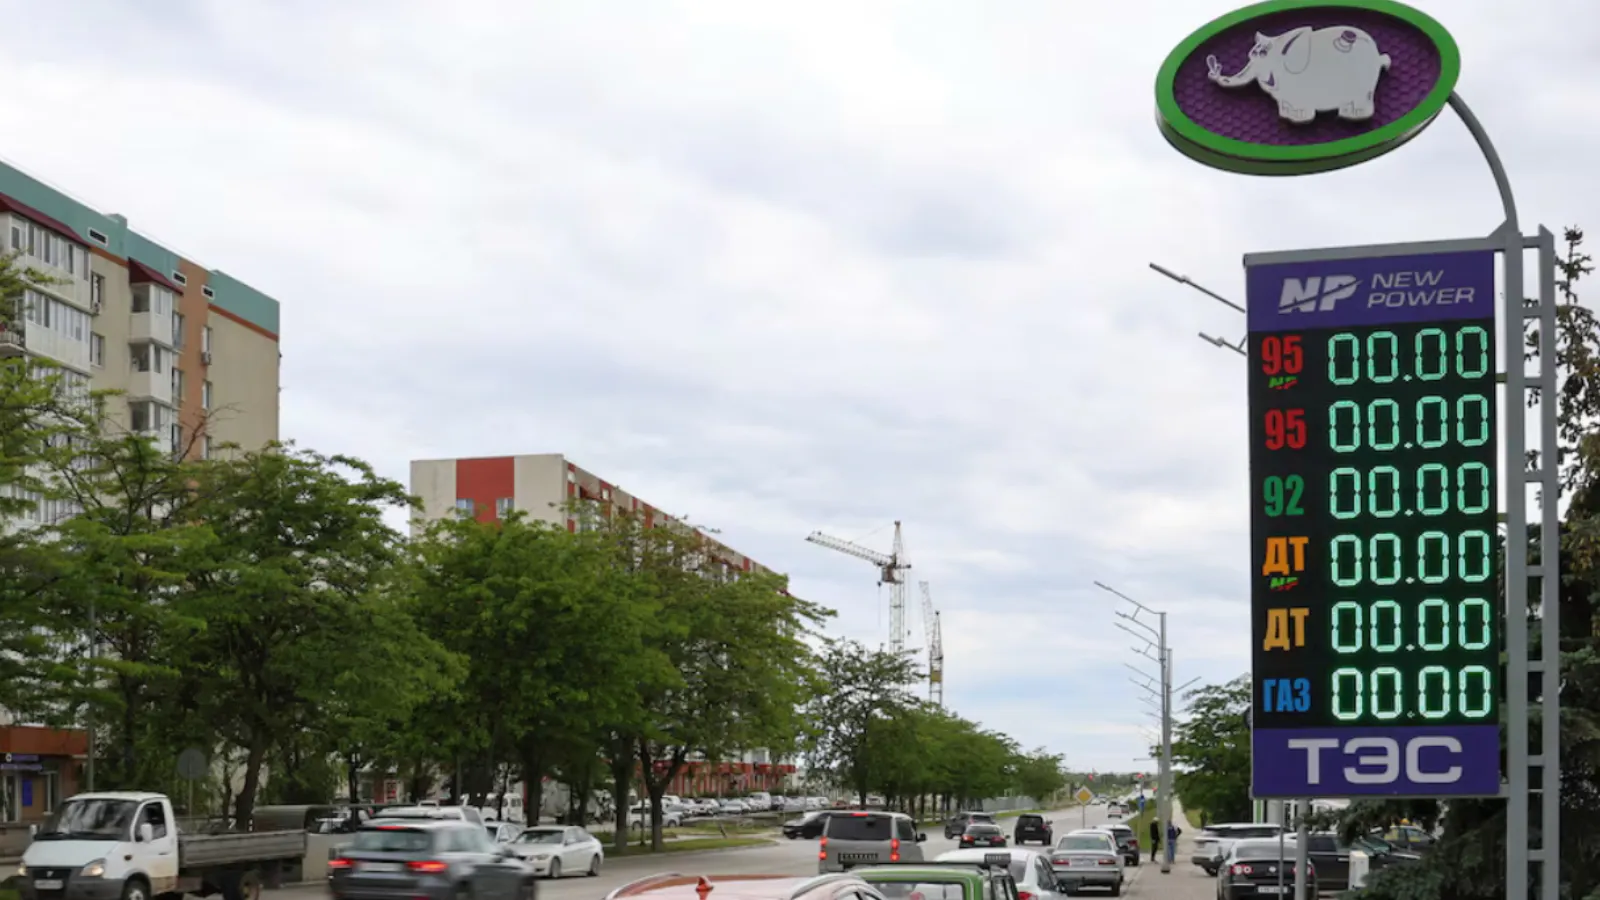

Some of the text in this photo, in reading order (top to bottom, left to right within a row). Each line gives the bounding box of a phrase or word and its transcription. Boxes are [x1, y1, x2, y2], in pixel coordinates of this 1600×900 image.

[1278, 275, 1361, 314] NP
[1367, 286, 1475, 309] POWER
[1371, 270, 1444, 290] NEW
[1261, 326, 1488, 386] 95 00.00
[1264, 394, 1489, 453] 95 00.00
[1263, 461, 1489, 520] 92 00.00
[1262, 530, 1490, 587] ДТ 00.00
[1263, 597, 1491, 653] ДТ 00.00
[1263, 665, 1491, 720] ГАЗ 00.00
[1288, 737, 1463, 784] ТЭС
